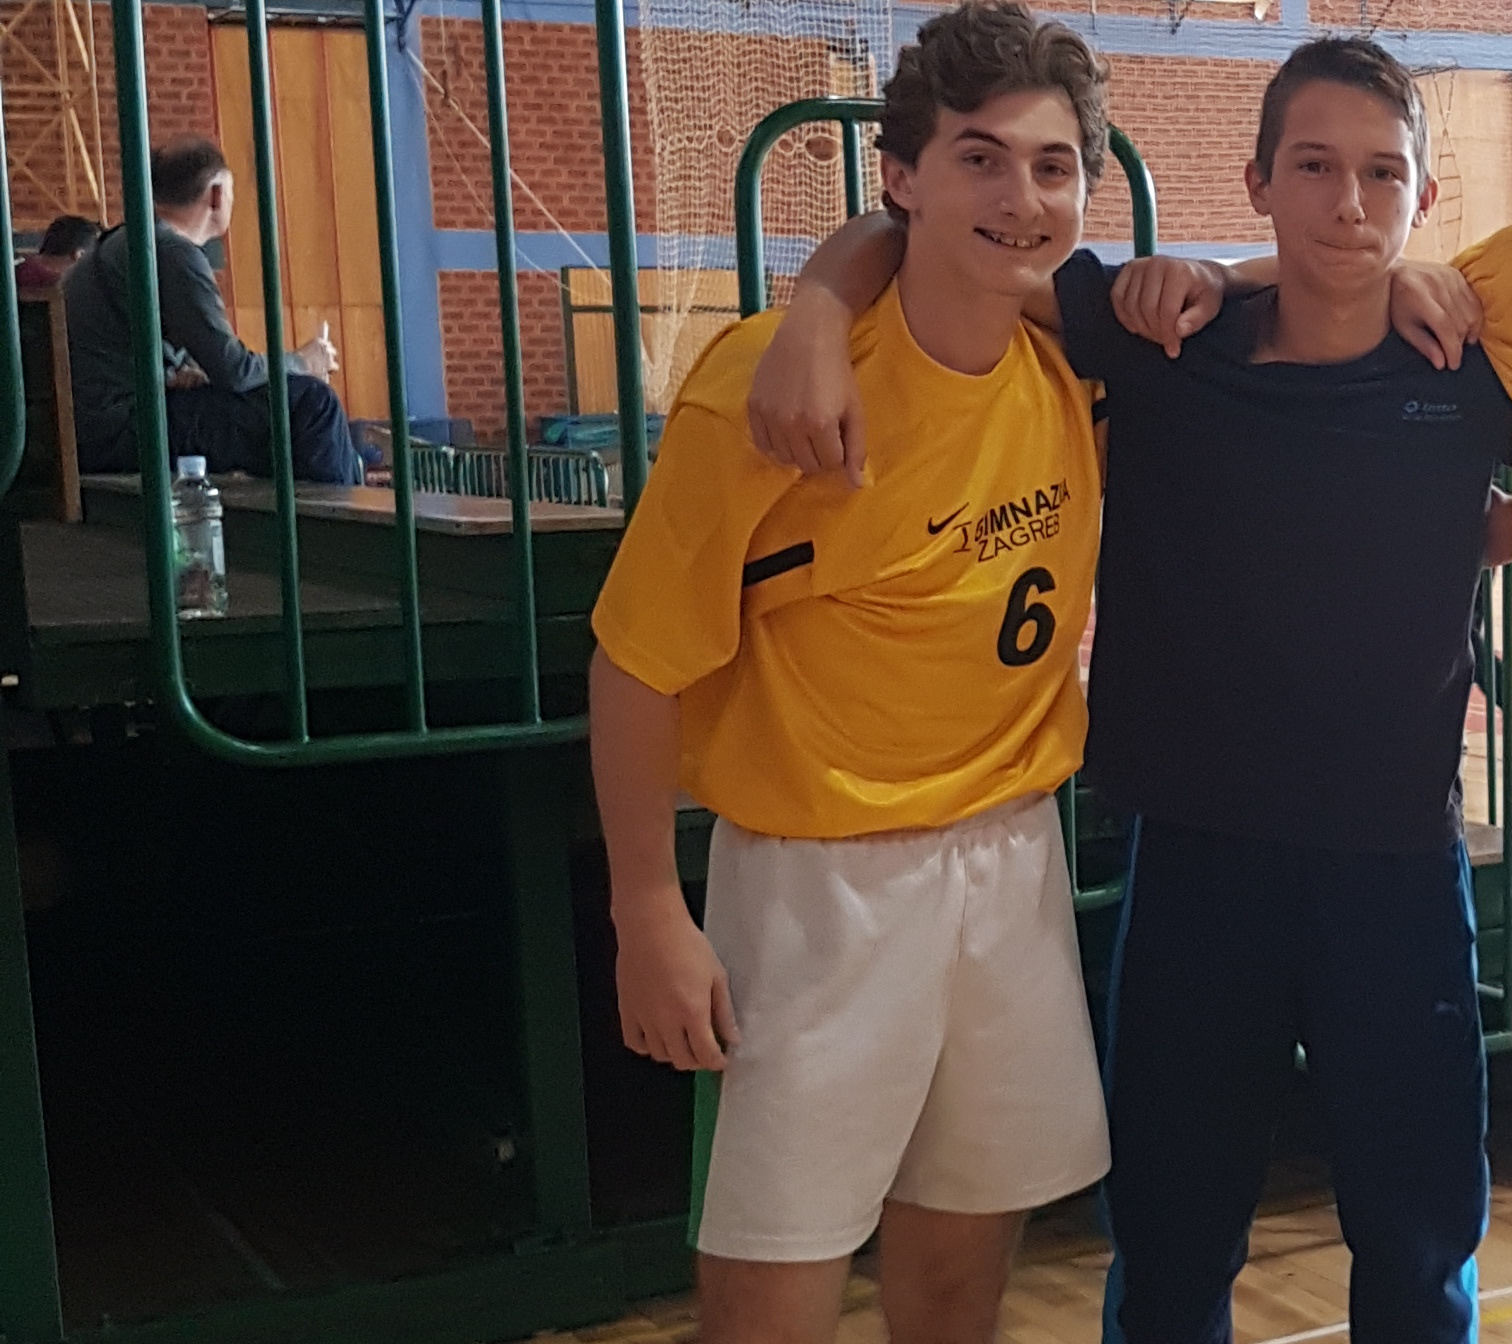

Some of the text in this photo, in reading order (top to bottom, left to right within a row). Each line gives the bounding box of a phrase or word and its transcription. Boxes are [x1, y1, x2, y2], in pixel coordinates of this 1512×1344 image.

[974, 477, 1071, 543] GIMNAZA
[978, 513, 1061, 564] ZAGREB
[996, 566, 1056, 668] 6
